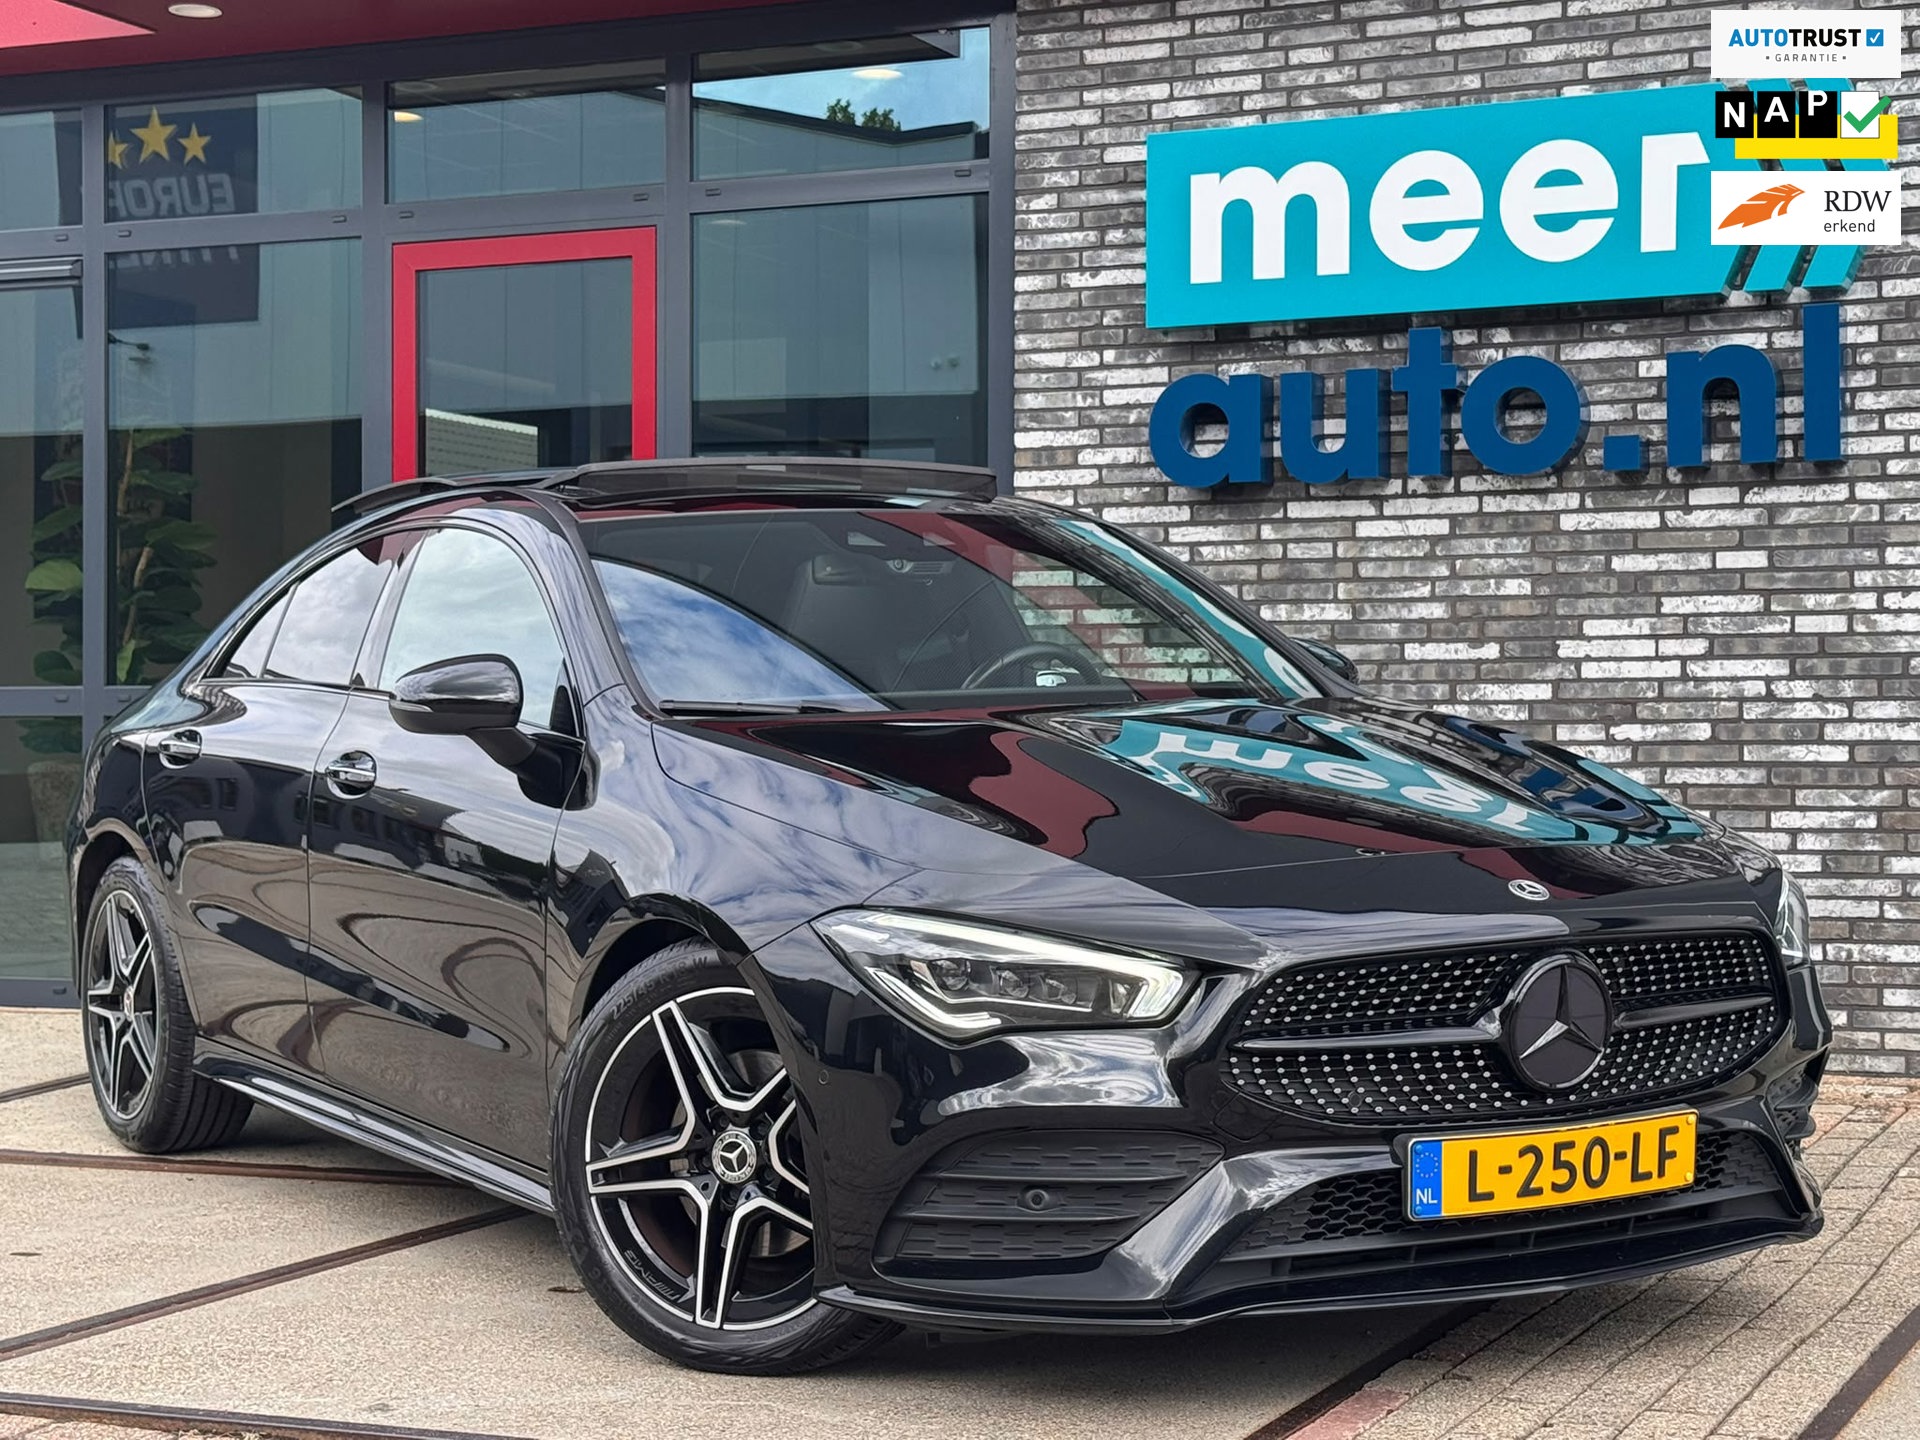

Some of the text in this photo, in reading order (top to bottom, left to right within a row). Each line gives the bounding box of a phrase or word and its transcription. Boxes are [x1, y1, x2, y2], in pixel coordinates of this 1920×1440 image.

[1189, 131, 1710, 284] meer
[1149, 303, 1845, 488] auto.nl
[1415, 1187, 1438, 1205] NL
[1467, 1125, 1680, 1203] L-250-LF
